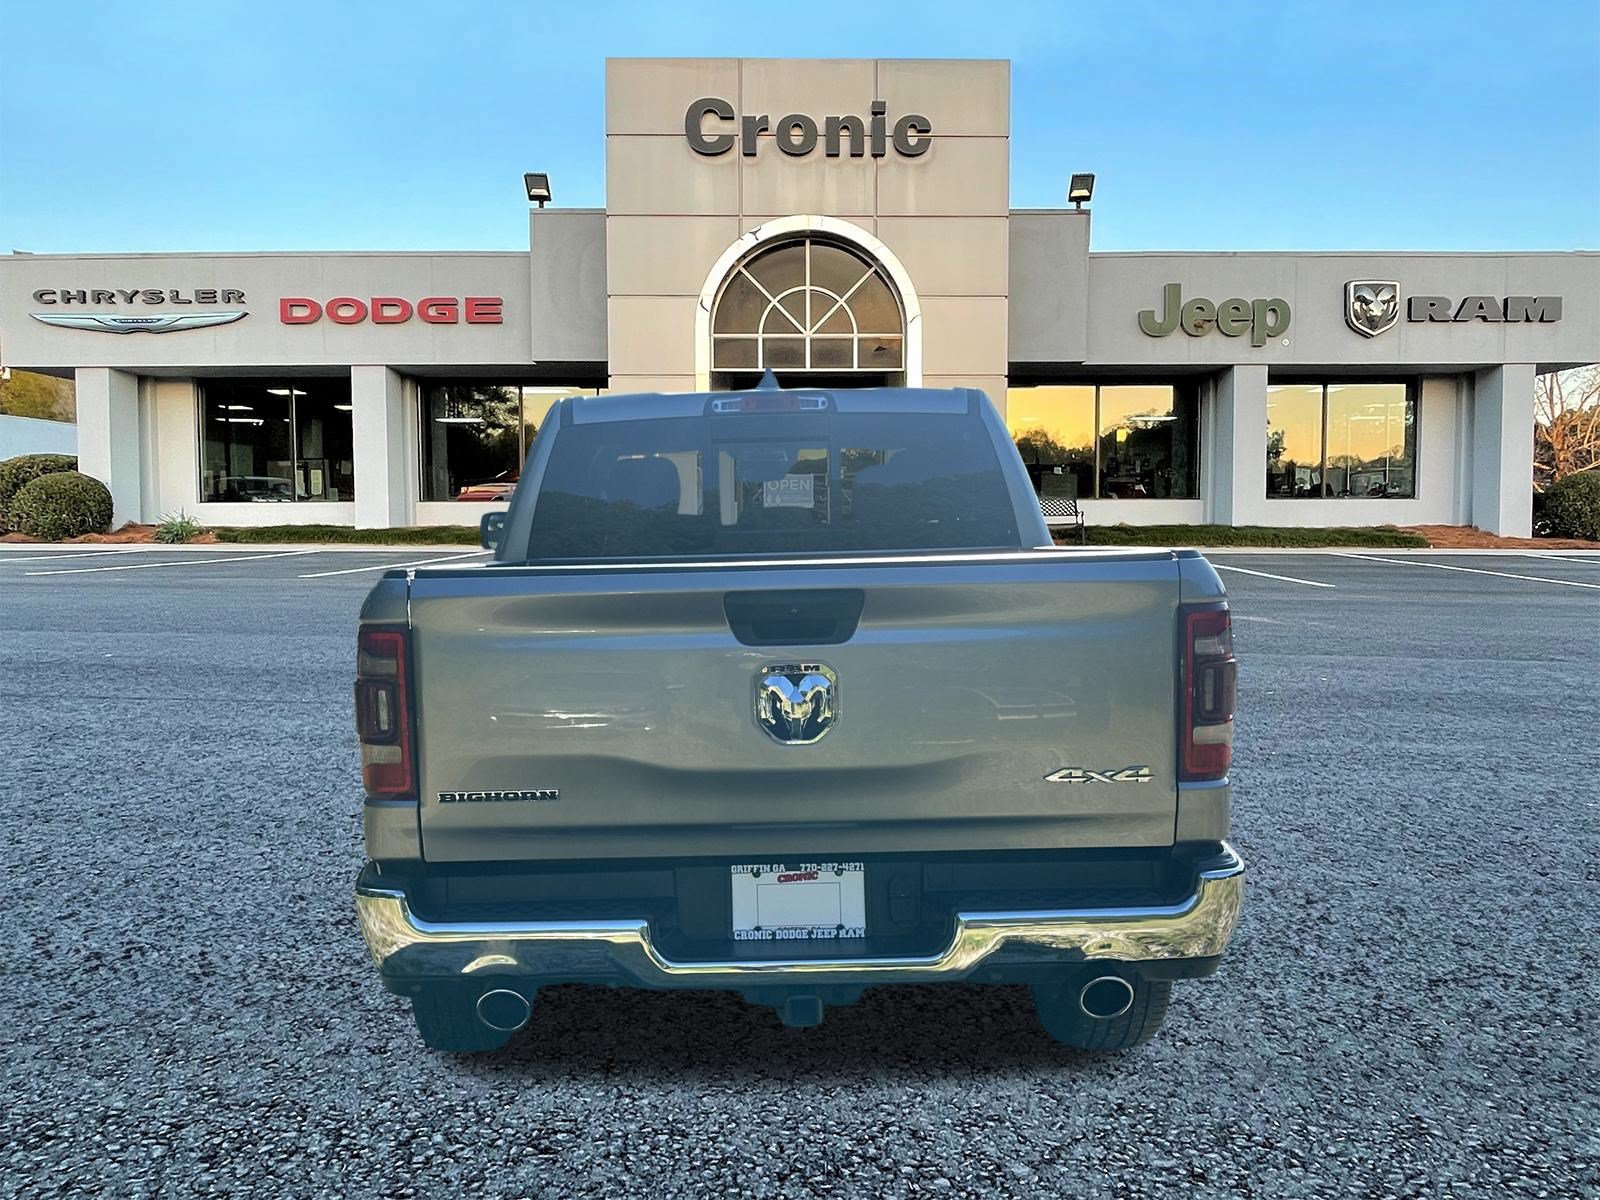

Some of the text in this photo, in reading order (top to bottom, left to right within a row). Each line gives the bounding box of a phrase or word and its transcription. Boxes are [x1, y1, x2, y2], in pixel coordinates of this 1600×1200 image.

[684, 97, 932, 157] Cronic
[32, 289, 246, 304] CHRYSLER
[280, 297, 503, 324] DODGE
[1138, 283, 1291, 347] Jeep
[1407, 296, 1562, 323] RAM
[767, 479, 810, 491] OPEN
[770, 664, 820, 672] RAM
[1043, 765, 1155, 784] 4x4
[438, 789, 559, 803] BIGHORN
[731, 864, 770, 874] GRIFFIN
[772, 863, 786, 873] GA
[734, 930, 772, 940] CRONIC
[775, 929, 809, 940] DODGE
[811, 928, 838, 939] JEEP
[840, 928, 865, 938] RAM
